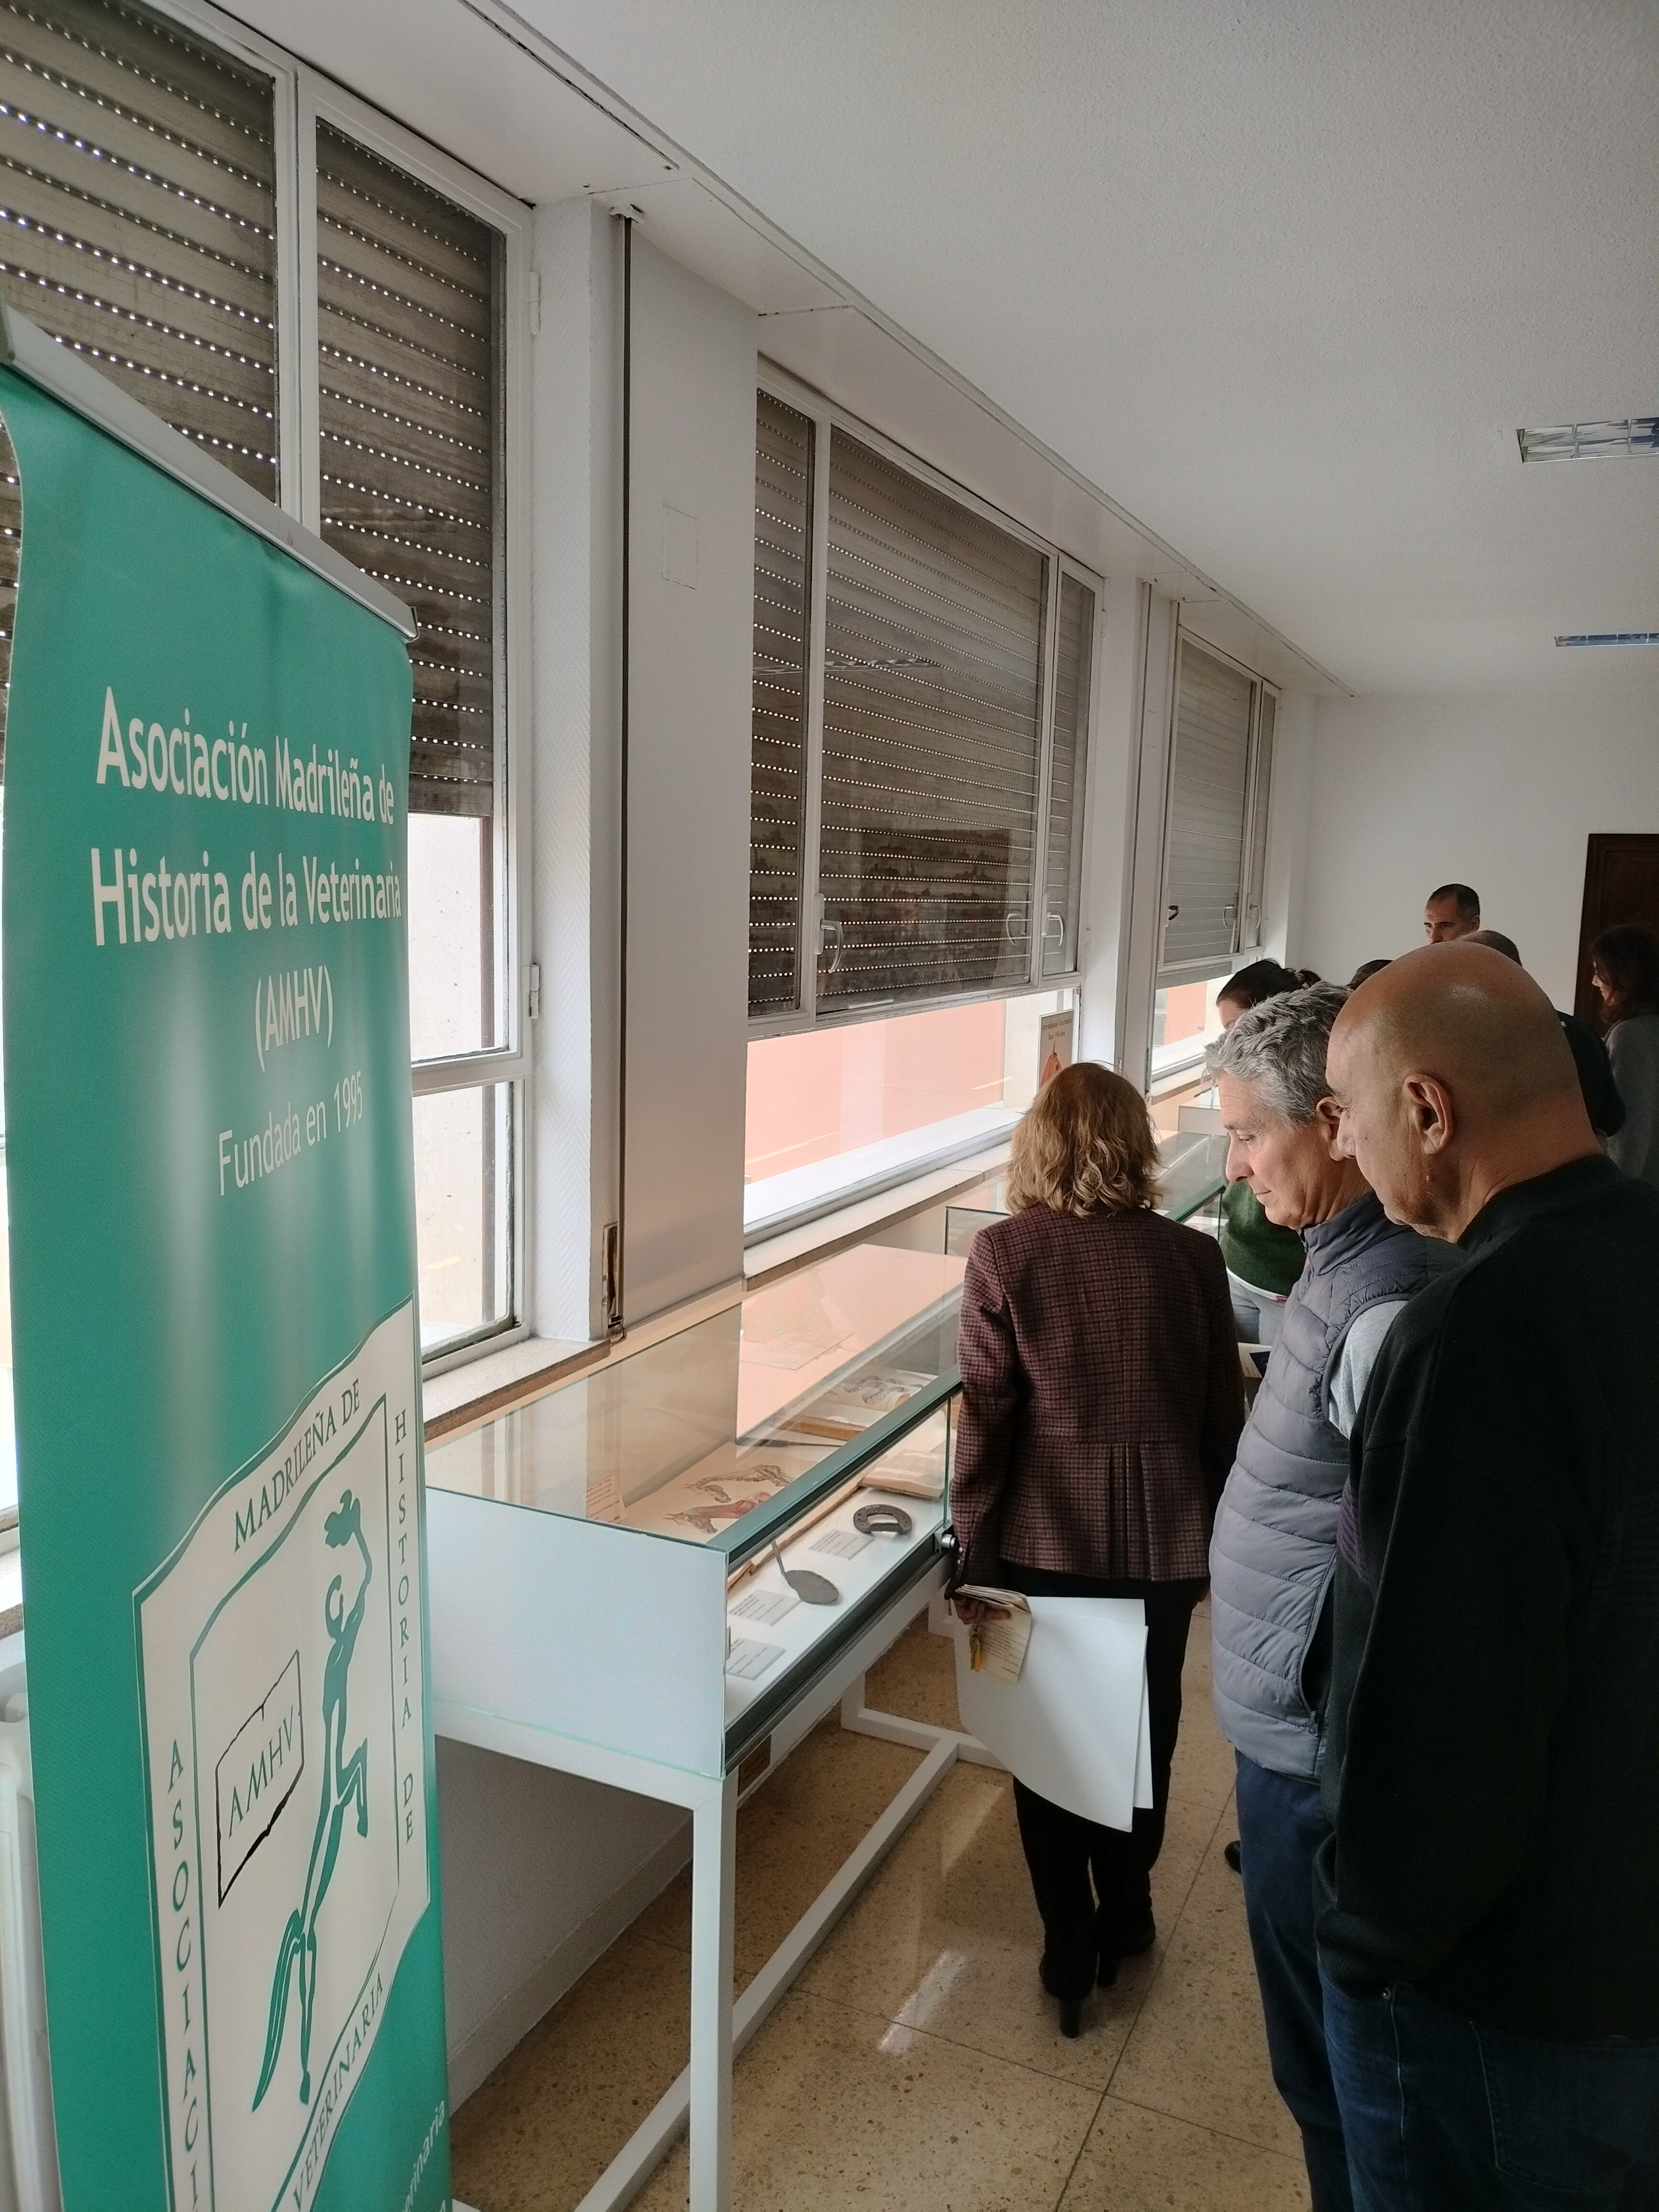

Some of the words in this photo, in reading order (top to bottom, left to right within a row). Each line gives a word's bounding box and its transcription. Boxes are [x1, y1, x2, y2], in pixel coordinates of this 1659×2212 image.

[96, 686, 269, 806] Asociación
[275, 735, 376, 822] Madrileña
[379, 764, 395, 826] de
[91, 847, 232, 946] Historia
[242, 851, 273, 931] de
[278, 852, 298, 928] la
[302, 856, 402, 925] Veterinaria
[254, 965, 335, 1073] (AMHV)
[218, 1101, 301, 1197] Fundada
[306, 1100, 328, 1145] en
[333, 1071, 364, 1134] 1995
[234, 1405, 337, 1553] MADRILEÑA
[341, 1378, 361, 1427] DE
[394, 1408, 414, 1729] HISTORIA
[228, 1704, 294, 1839] AMHV
[402, 1771, 415, 1845] DE
[167, 1738, 199, 2212] ASOCIACI
[293, 1972, 385, 2212] VETERINARIA
[402, 2099, 445, 2212] erinaria
